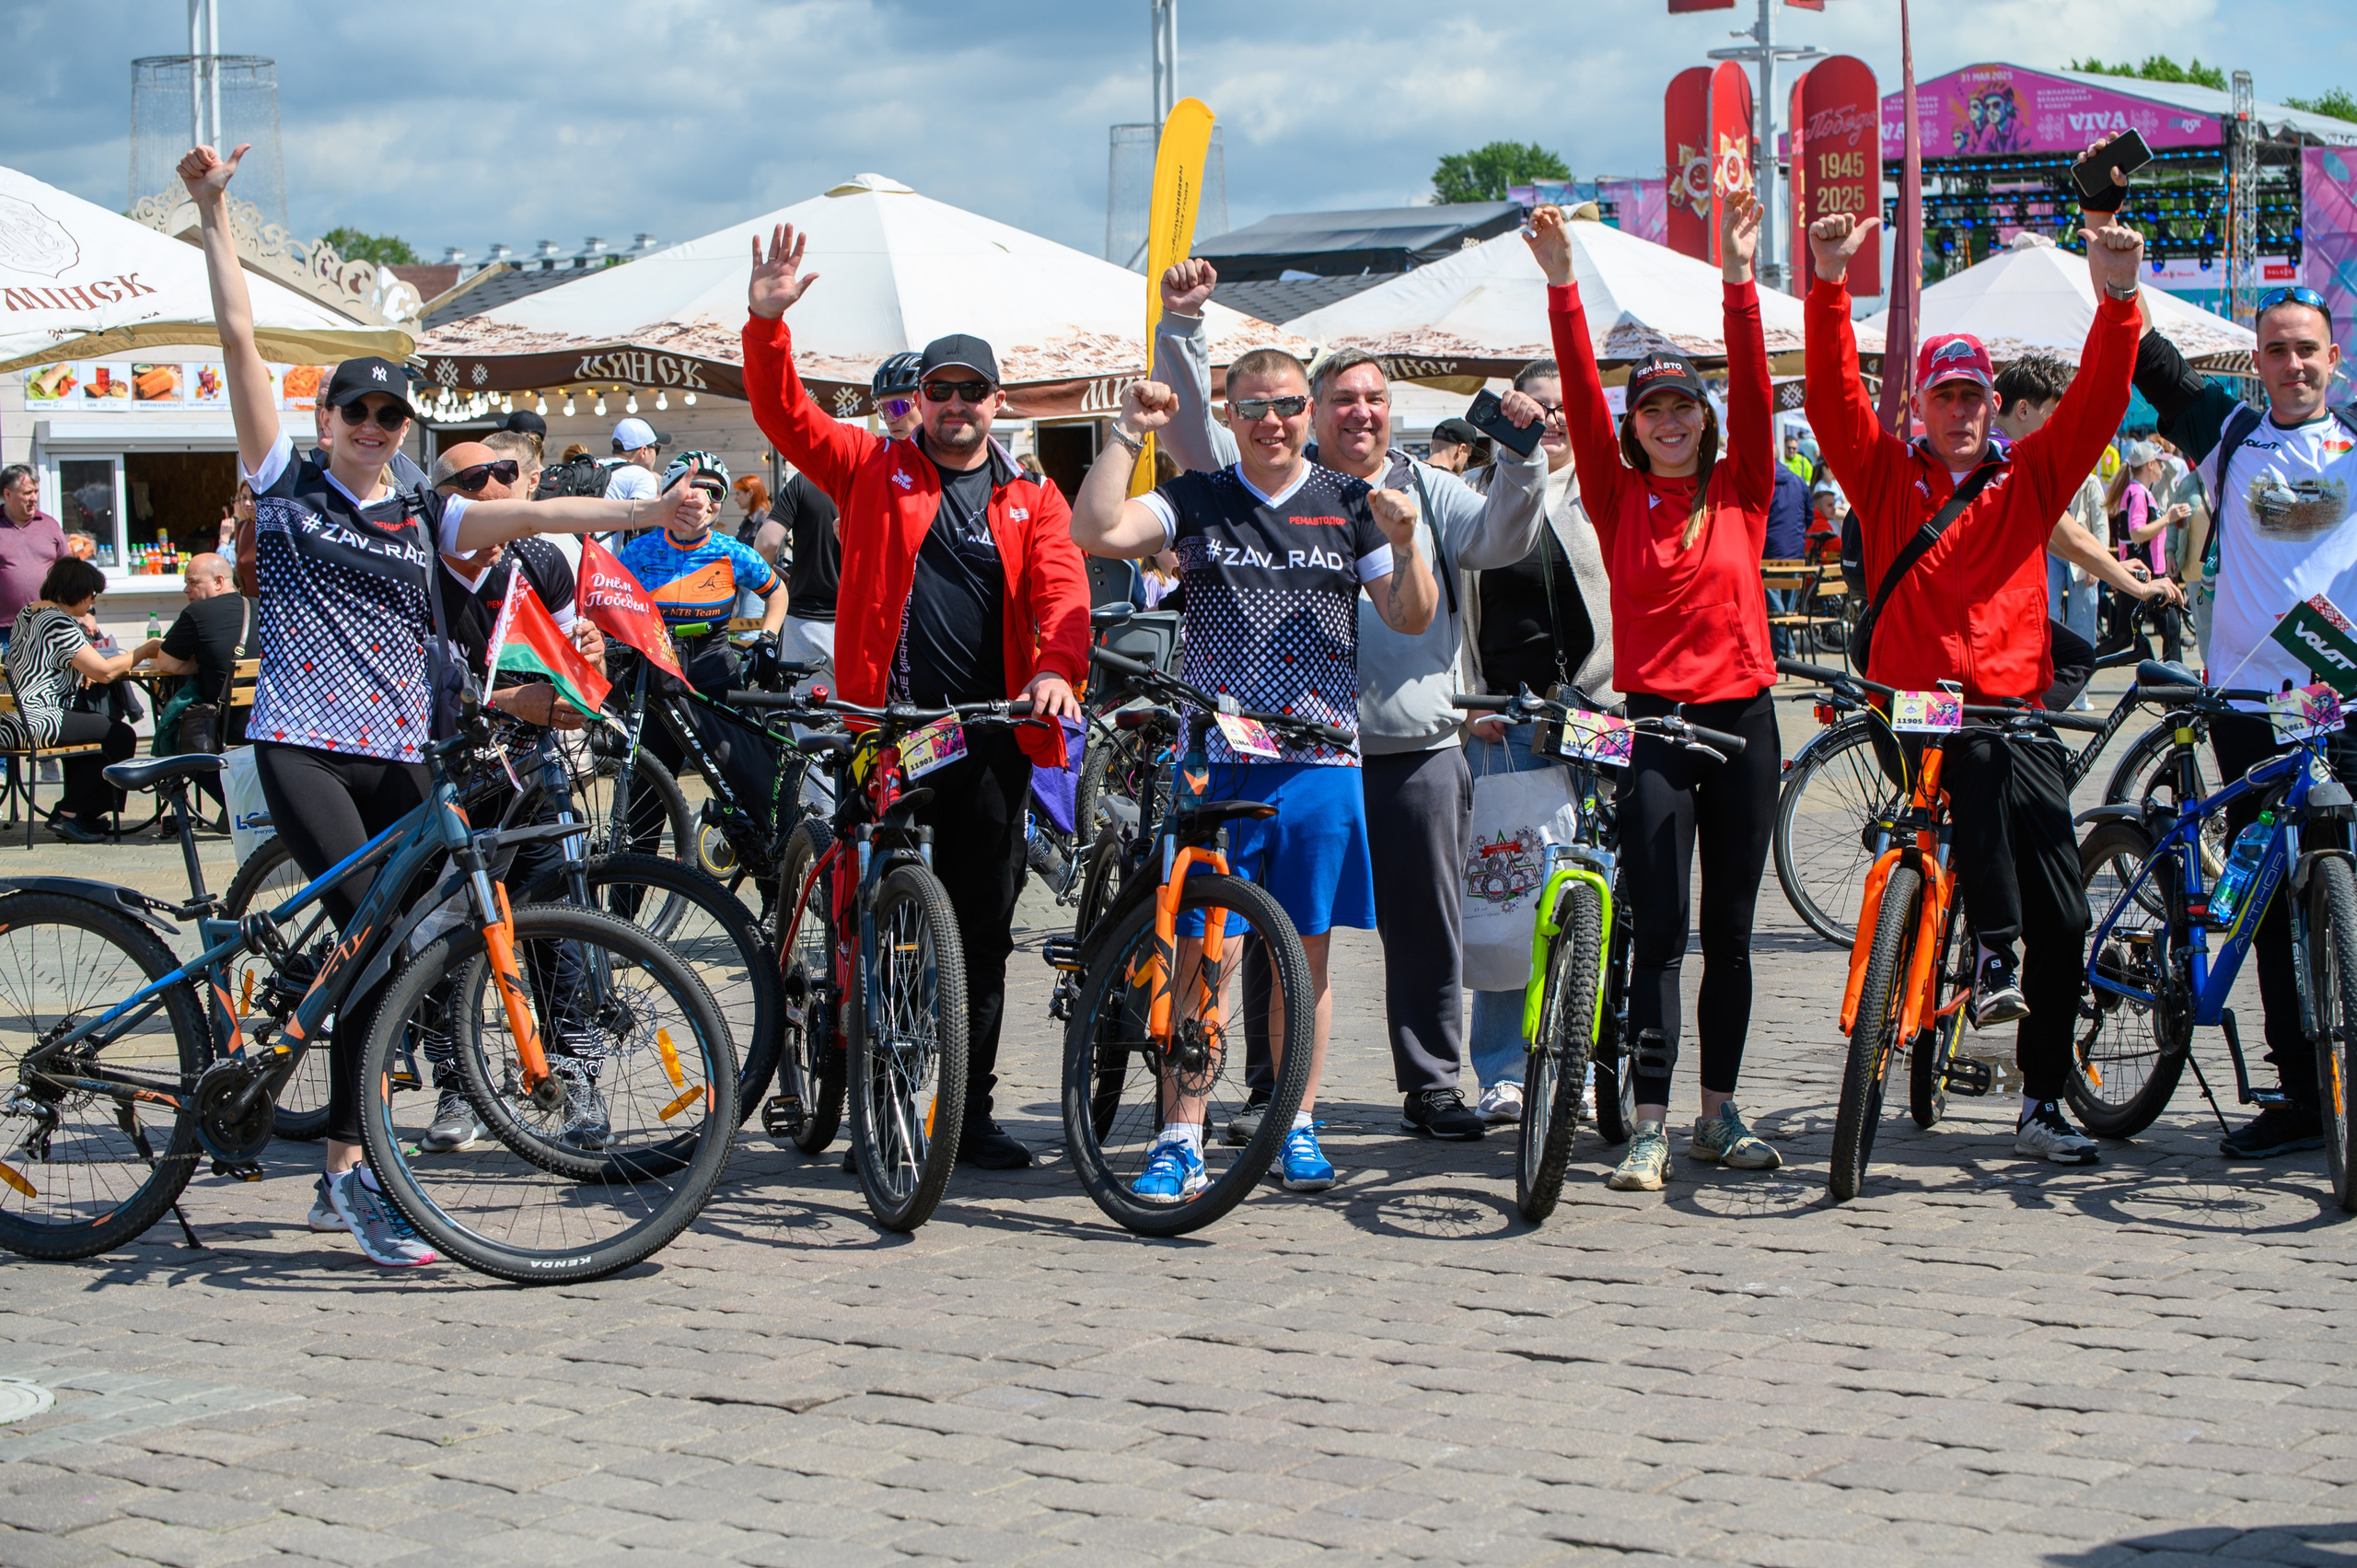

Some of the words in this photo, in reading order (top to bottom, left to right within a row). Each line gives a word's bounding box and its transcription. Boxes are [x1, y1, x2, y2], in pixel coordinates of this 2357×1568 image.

[2068, 110, 2128, 131] VIVA
[1818, 152, 1865, 180] 1945
[1817, 185, 1866, 214] 2025
[575, 351, 708, 389] МИНСК
[1289, 516, 1347, 527] РЕМАВТОДОР
[1206, 538, 1344, 572] #ZAV_RAD
[591, 572, 633, 593] Днём
[584, 590, 650, 614] Победы!
[670, 608, 691, 617] MTB
[694, 607, 721, 618] Team
[910, 756, 933, 772] 11903
[2235, 852, 2286, 954] AUTHOR
[76, 1079, 111, 1091] ROCKY
[530, 1256, 592, 1269] KENDA
